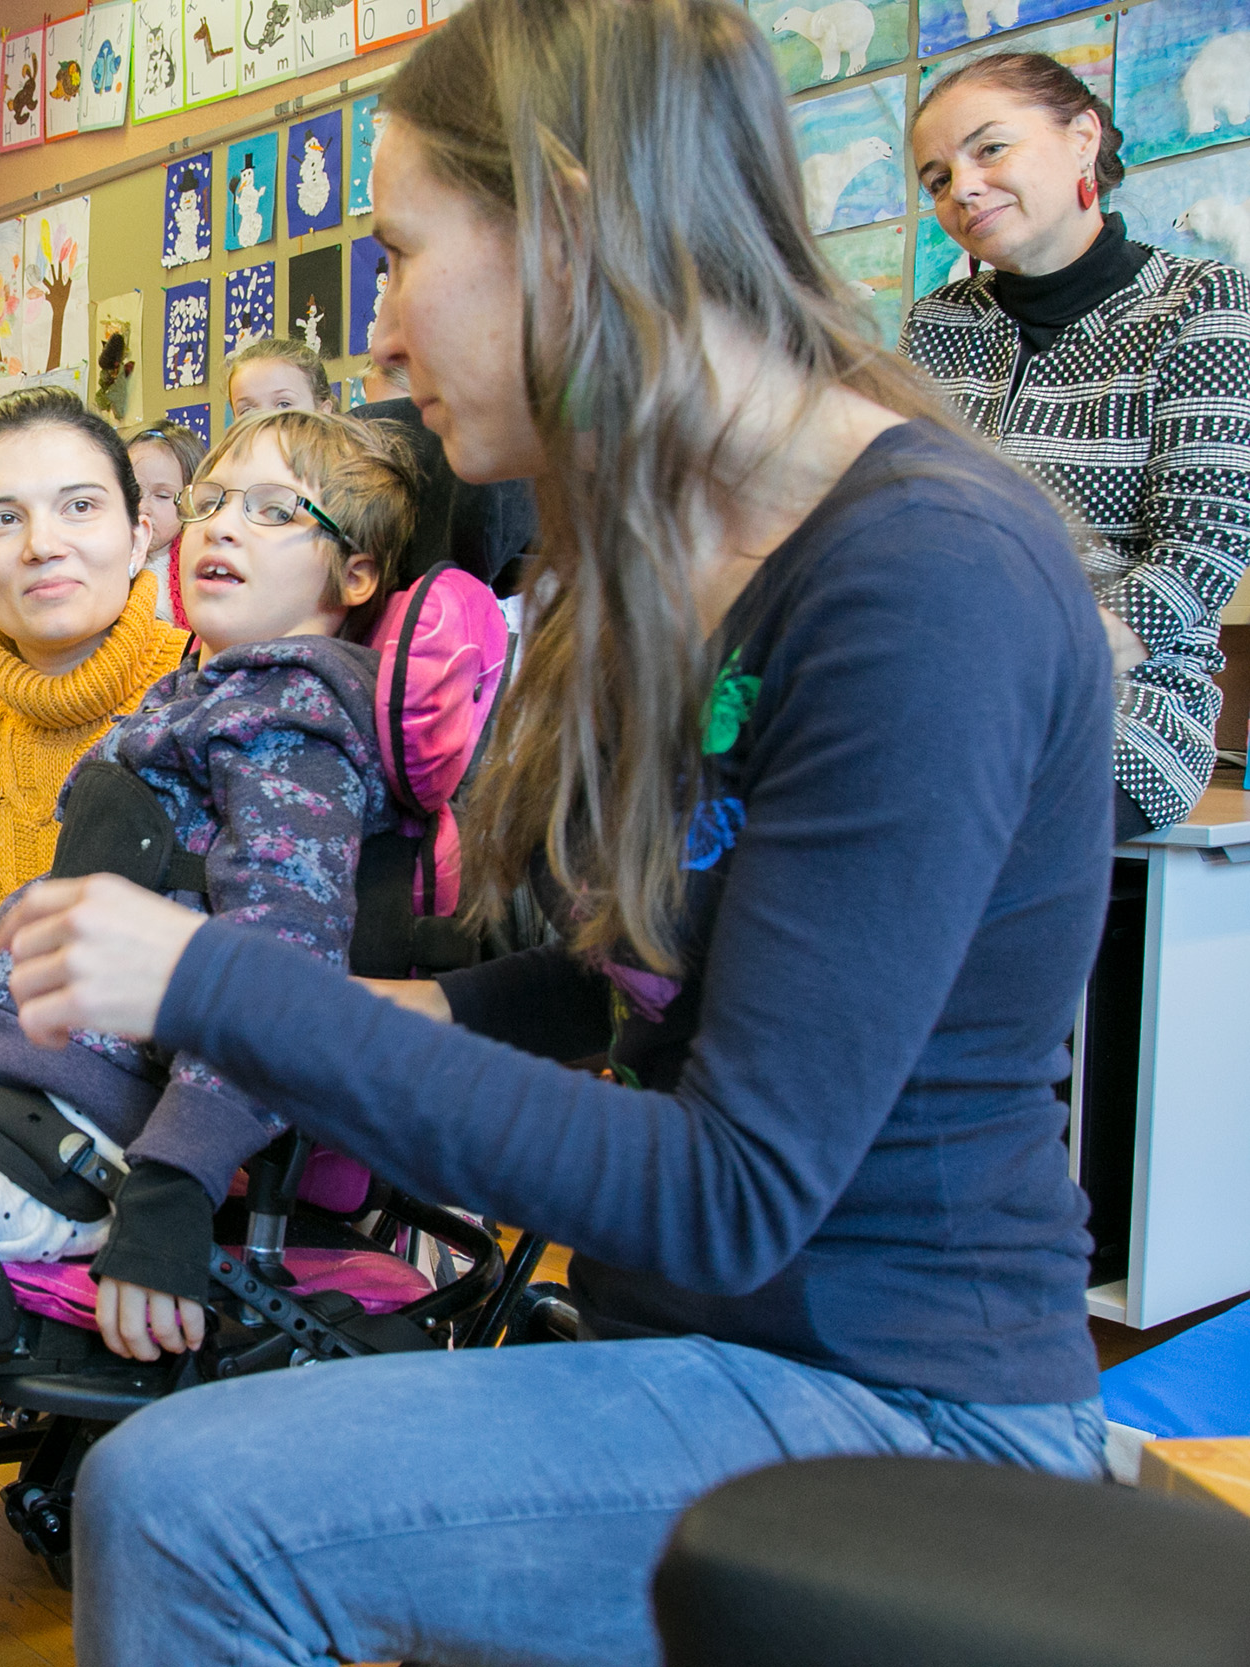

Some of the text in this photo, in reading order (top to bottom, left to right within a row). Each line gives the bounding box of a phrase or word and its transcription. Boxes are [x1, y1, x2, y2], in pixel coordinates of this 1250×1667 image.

[136, 4, 149, 28] K
[362, 8, 376, 40] O
[301, 30, 349, 62] N n
[244, 57, 289, 81] M m
[191, 72, 200, 96] L
